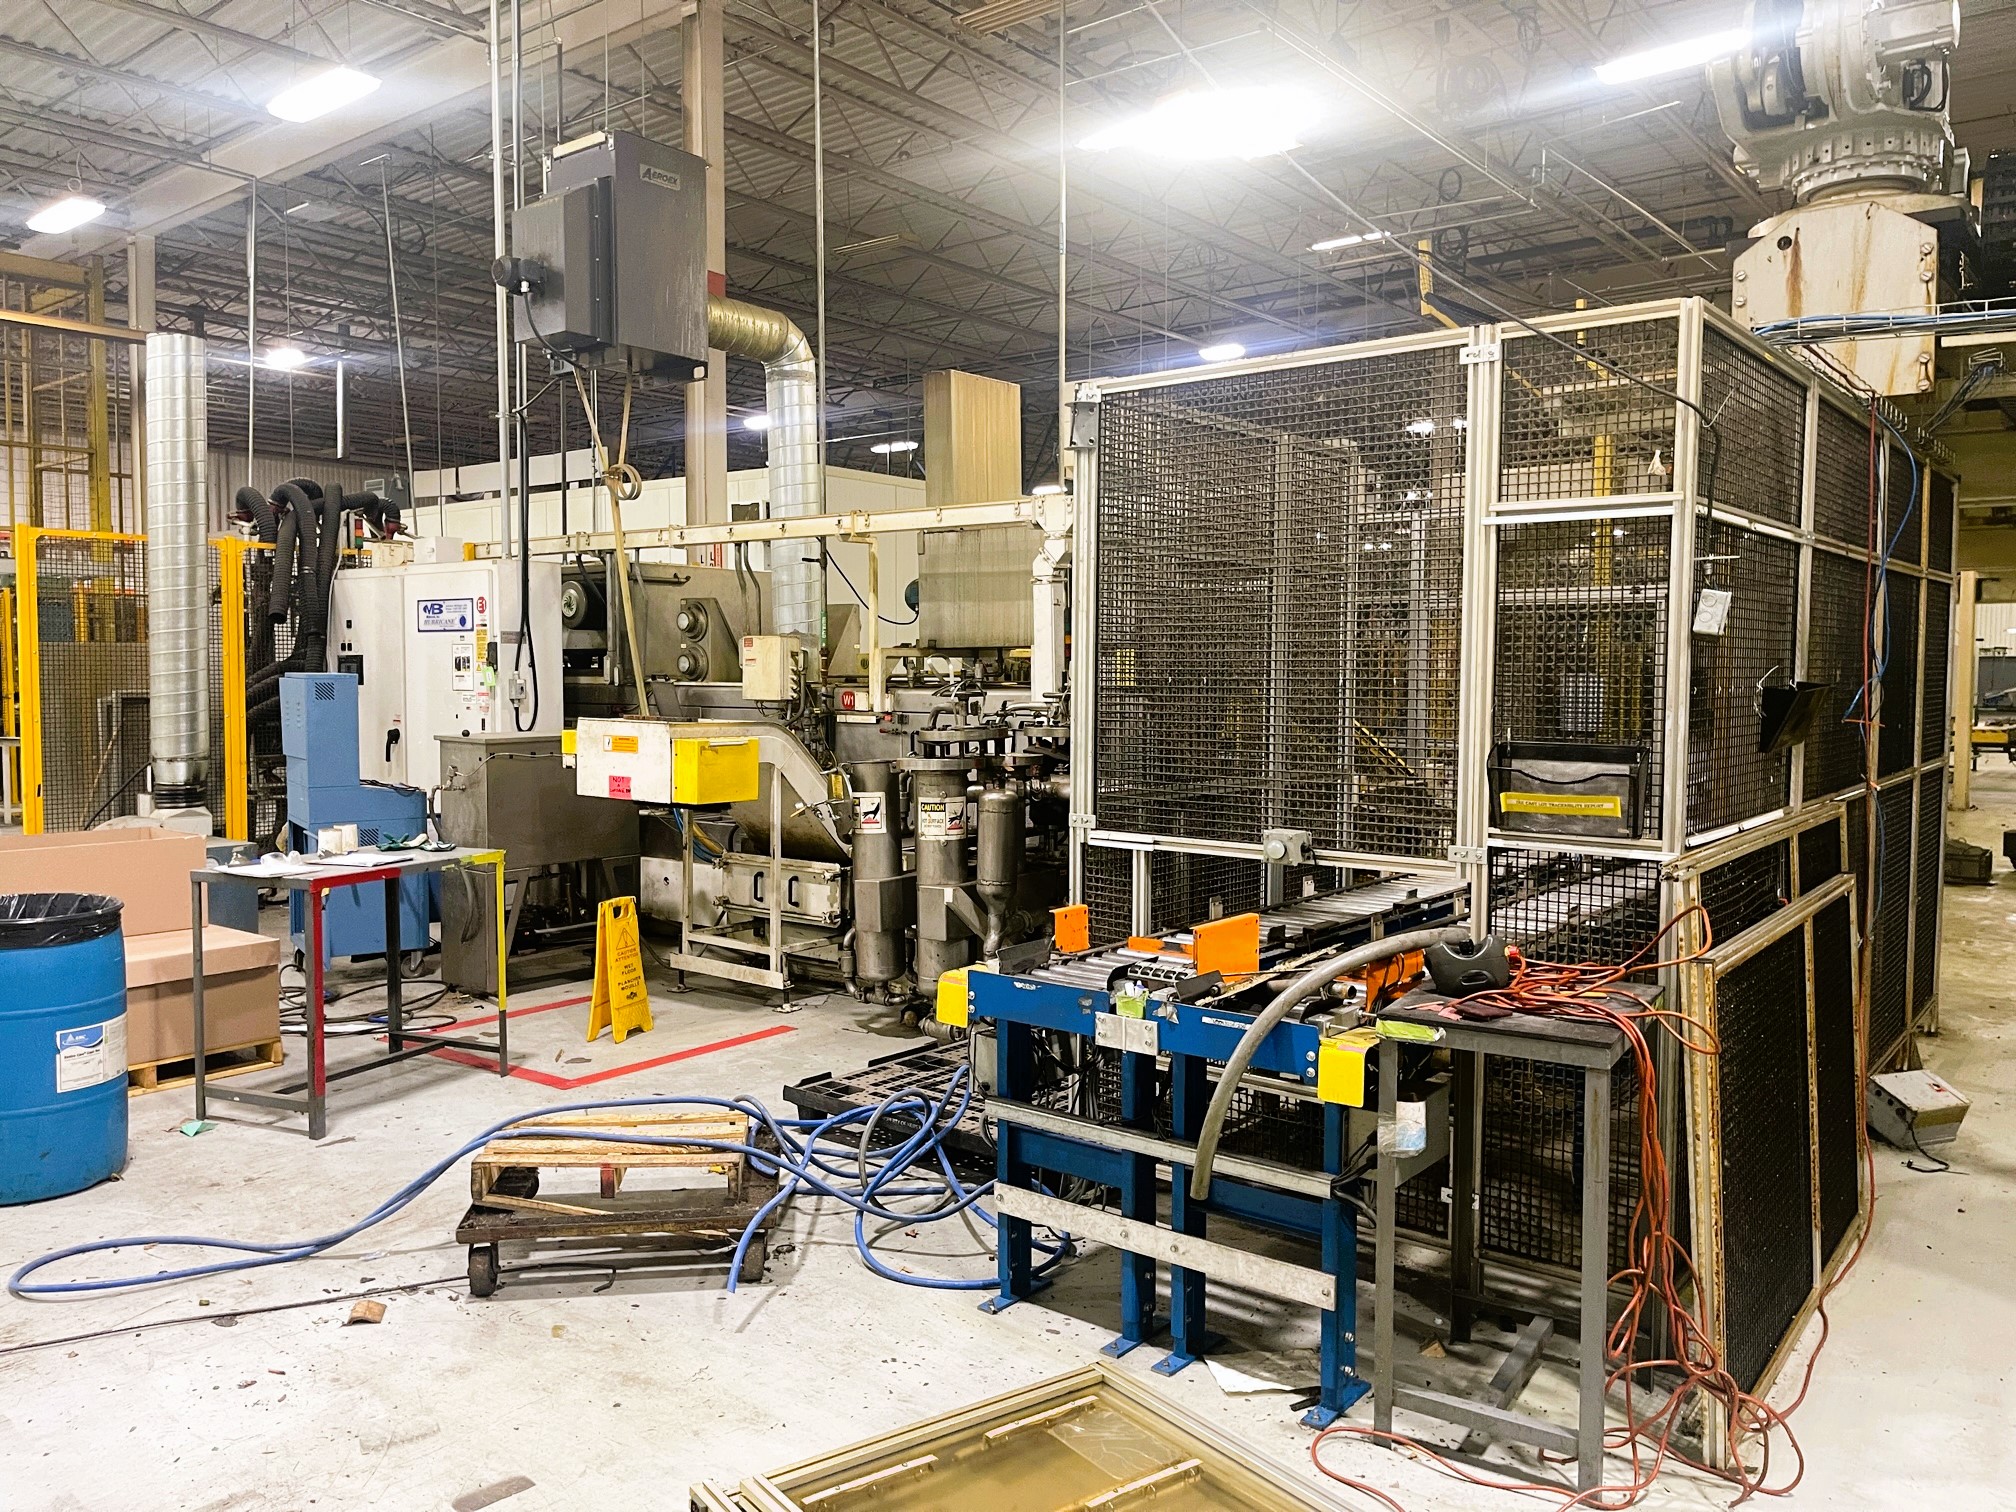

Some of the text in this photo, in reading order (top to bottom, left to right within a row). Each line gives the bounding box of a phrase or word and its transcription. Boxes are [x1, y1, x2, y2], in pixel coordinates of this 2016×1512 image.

[478, 600, 486, 609] E1
[843, 694, 854, 706] W1
[921, 803, 945, 811] CAUTION
